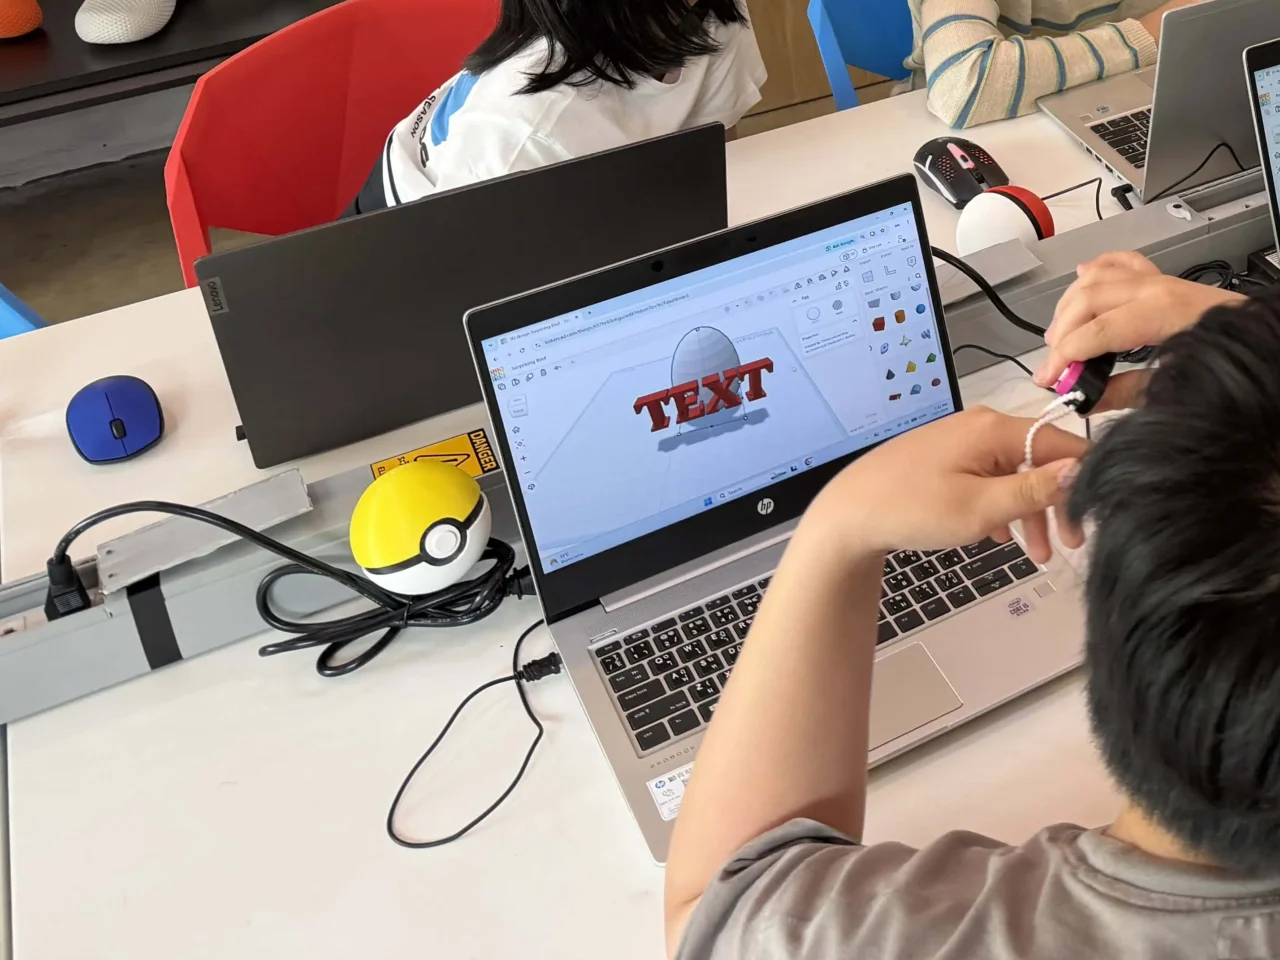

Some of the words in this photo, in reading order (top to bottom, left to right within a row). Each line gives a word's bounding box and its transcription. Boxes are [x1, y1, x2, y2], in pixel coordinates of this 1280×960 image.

[411, 95, 436, 138] SEASON
[207, 281, 224, 312] Lenovo
[633, 357, 774, 432] TEXT
[469, 431, 497, 471] DANGER
[757, 497, 775, 515] hp
